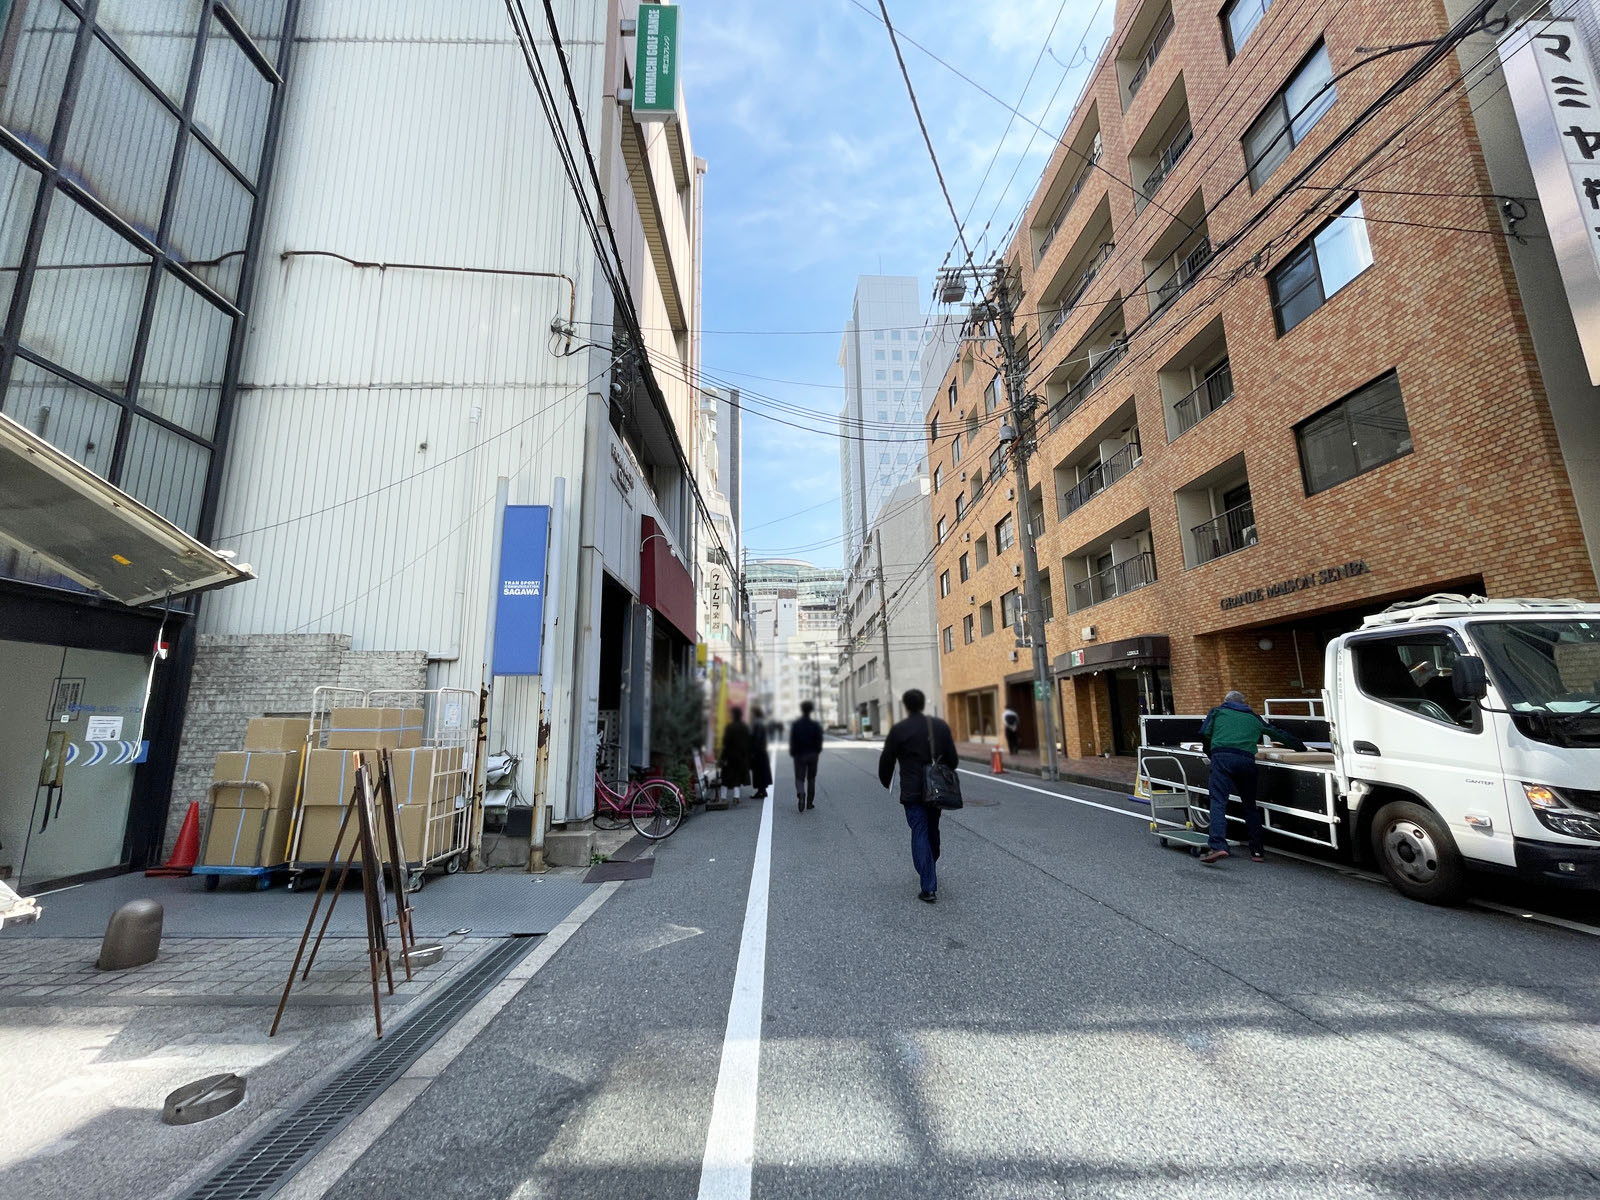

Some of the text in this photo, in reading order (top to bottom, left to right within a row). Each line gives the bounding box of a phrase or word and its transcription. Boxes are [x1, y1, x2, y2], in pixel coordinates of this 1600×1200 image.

[645, 9, 660, 104] HONMACHI GOLF RANGE
[503, 588, 540, 596] SAGAWA
[1220, 560, 1371, 610] GRANDE MAISON SENBA
